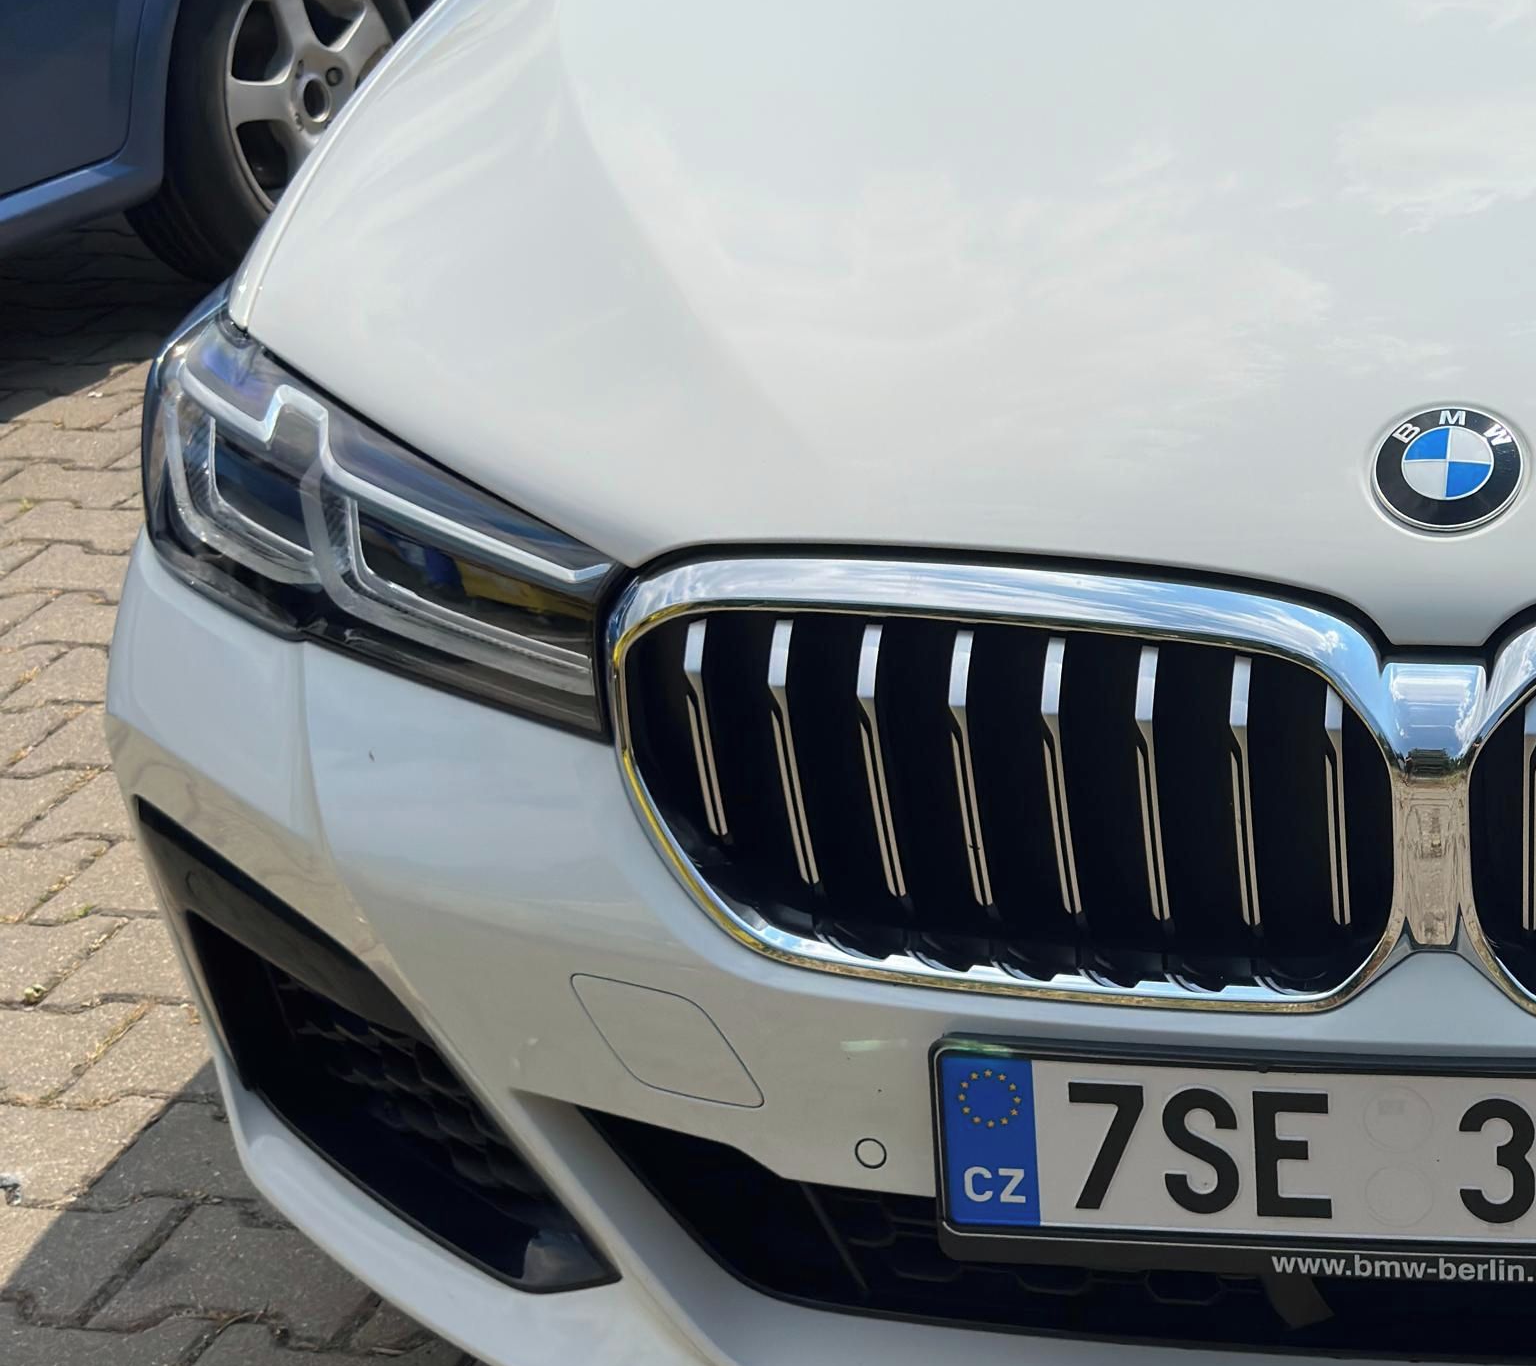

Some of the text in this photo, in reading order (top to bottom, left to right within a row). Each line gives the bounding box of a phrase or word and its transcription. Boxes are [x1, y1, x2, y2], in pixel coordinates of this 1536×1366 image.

[1391, 410, 1513, 446] BMW
[1067, 1081, 1333, 1220] 7SE
[963, 1166, 1027, 1204] CZ
